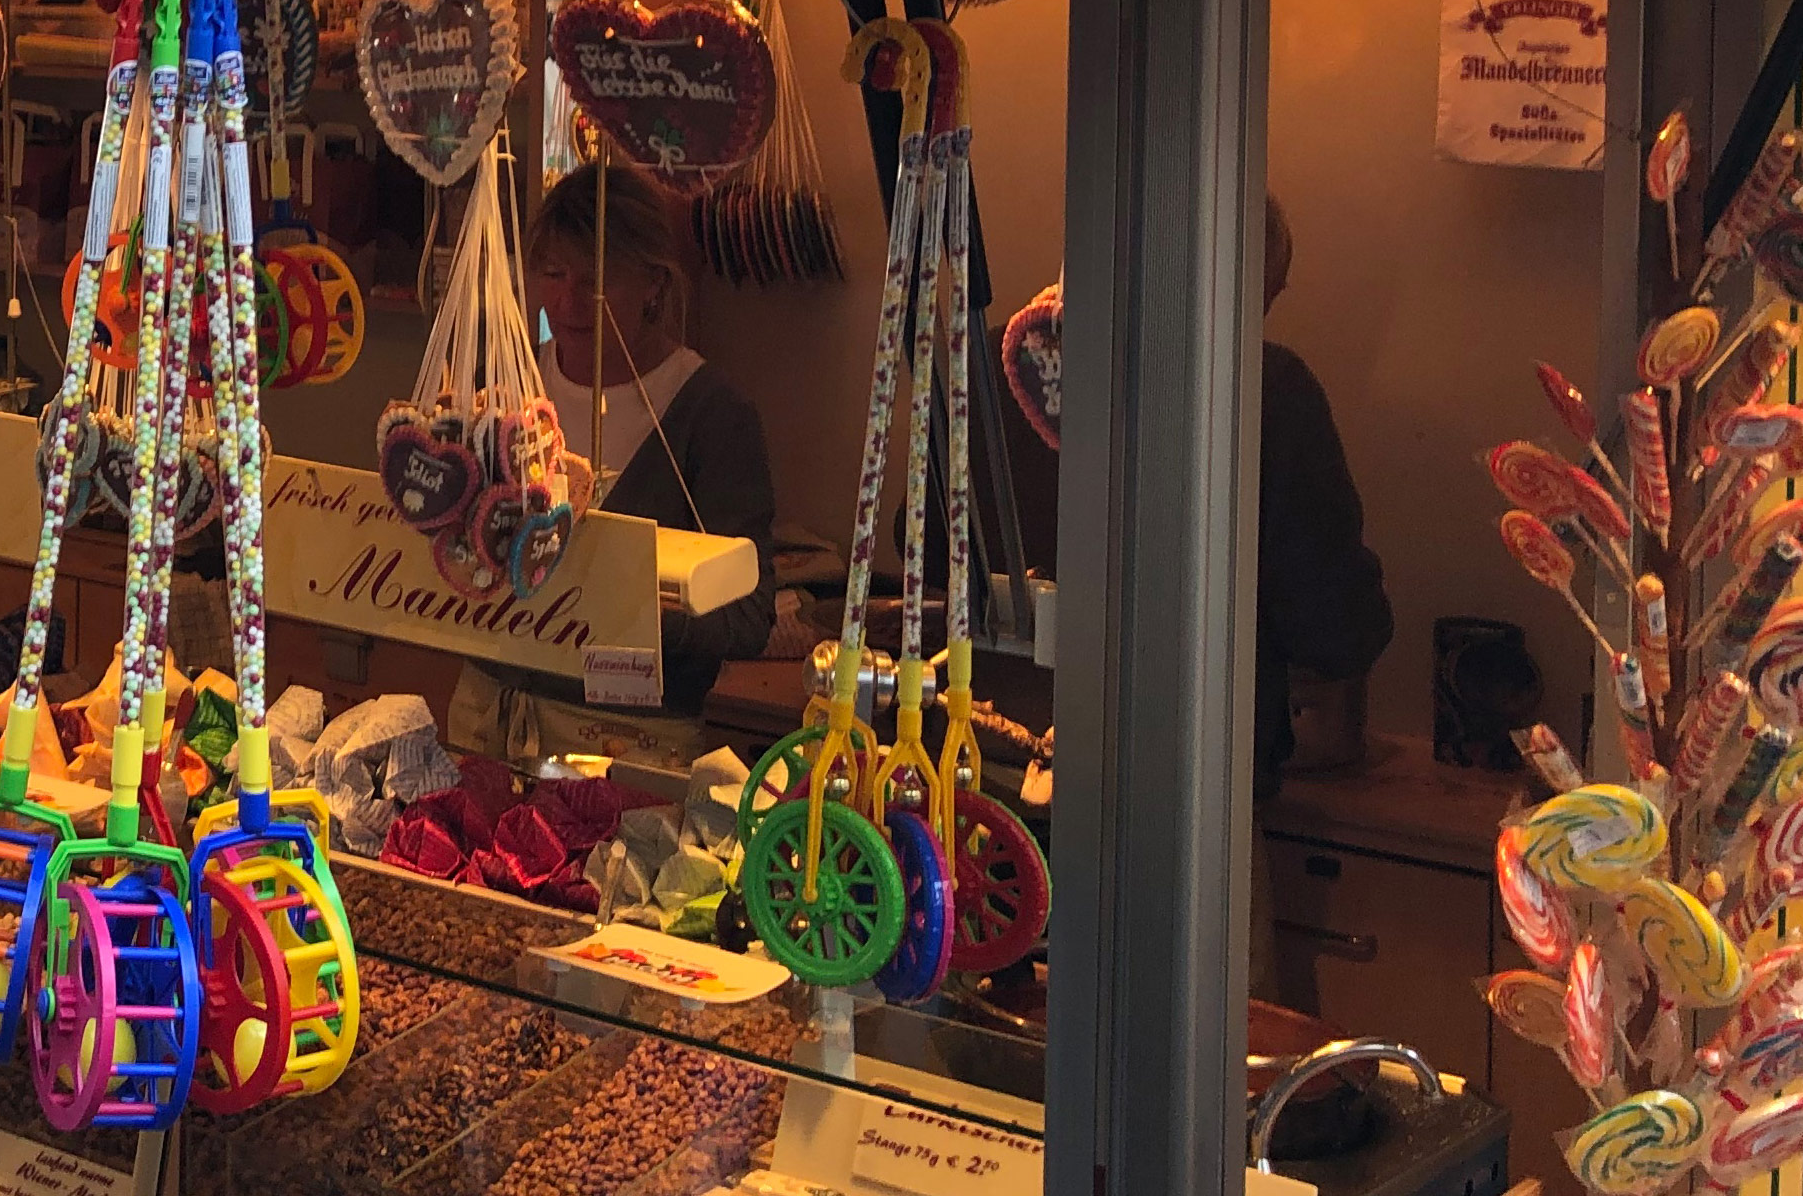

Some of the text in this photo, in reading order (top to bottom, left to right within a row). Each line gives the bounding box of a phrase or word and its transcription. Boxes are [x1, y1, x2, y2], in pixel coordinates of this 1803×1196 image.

[268, 472, 357, 513] frisch
[308, 543, 593, 650] Mandeln
[857, 1129, 912, 1158] Stange
